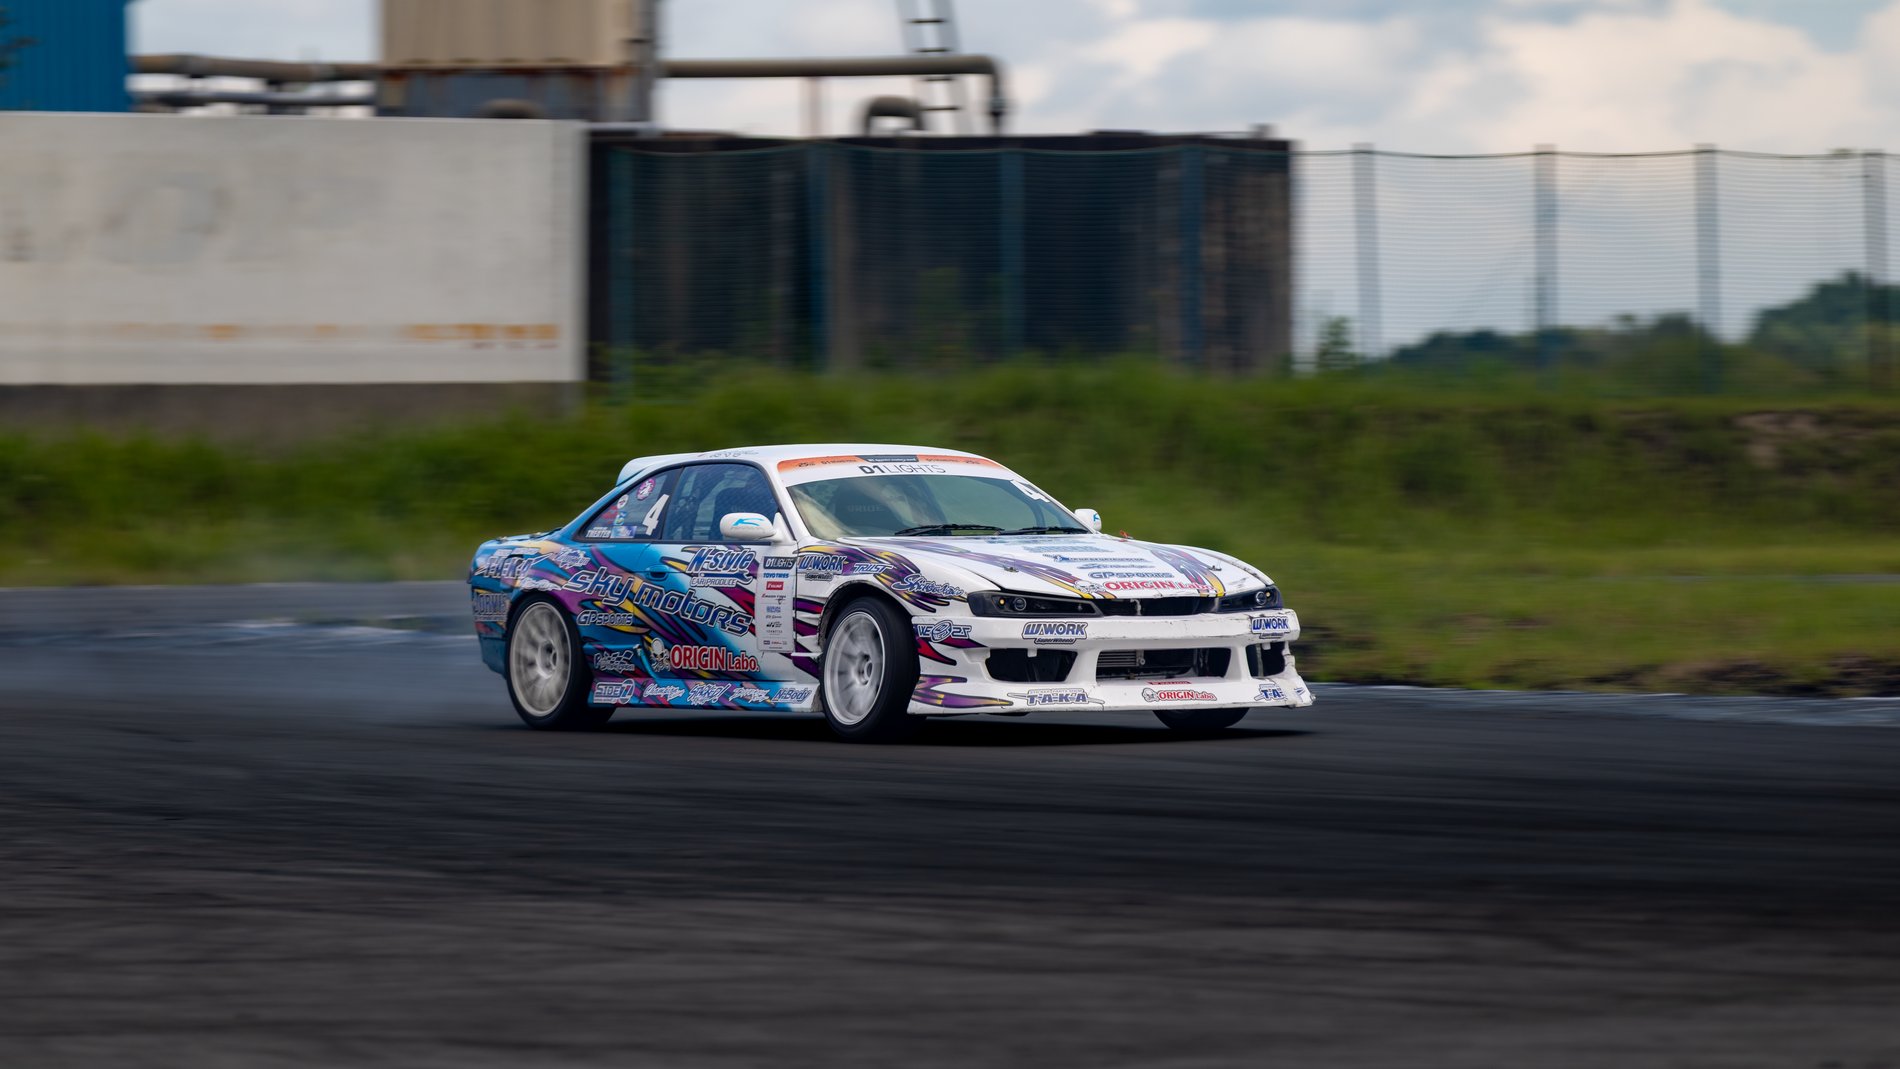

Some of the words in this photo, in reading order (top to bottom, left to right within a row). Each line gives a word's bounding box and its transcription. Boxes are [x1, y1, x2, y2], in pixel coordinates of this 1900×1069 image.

[1010, 480, 1050, 502] 4
[642, 494, 669, 536] 4
[1104, 581, 1175, 590] ORIGIN
[1043, 623, 1085, 636] WORK
[671, 645, 726, 670] ORIGIN
[1158, 690, 1194, 700] ORIGIN
